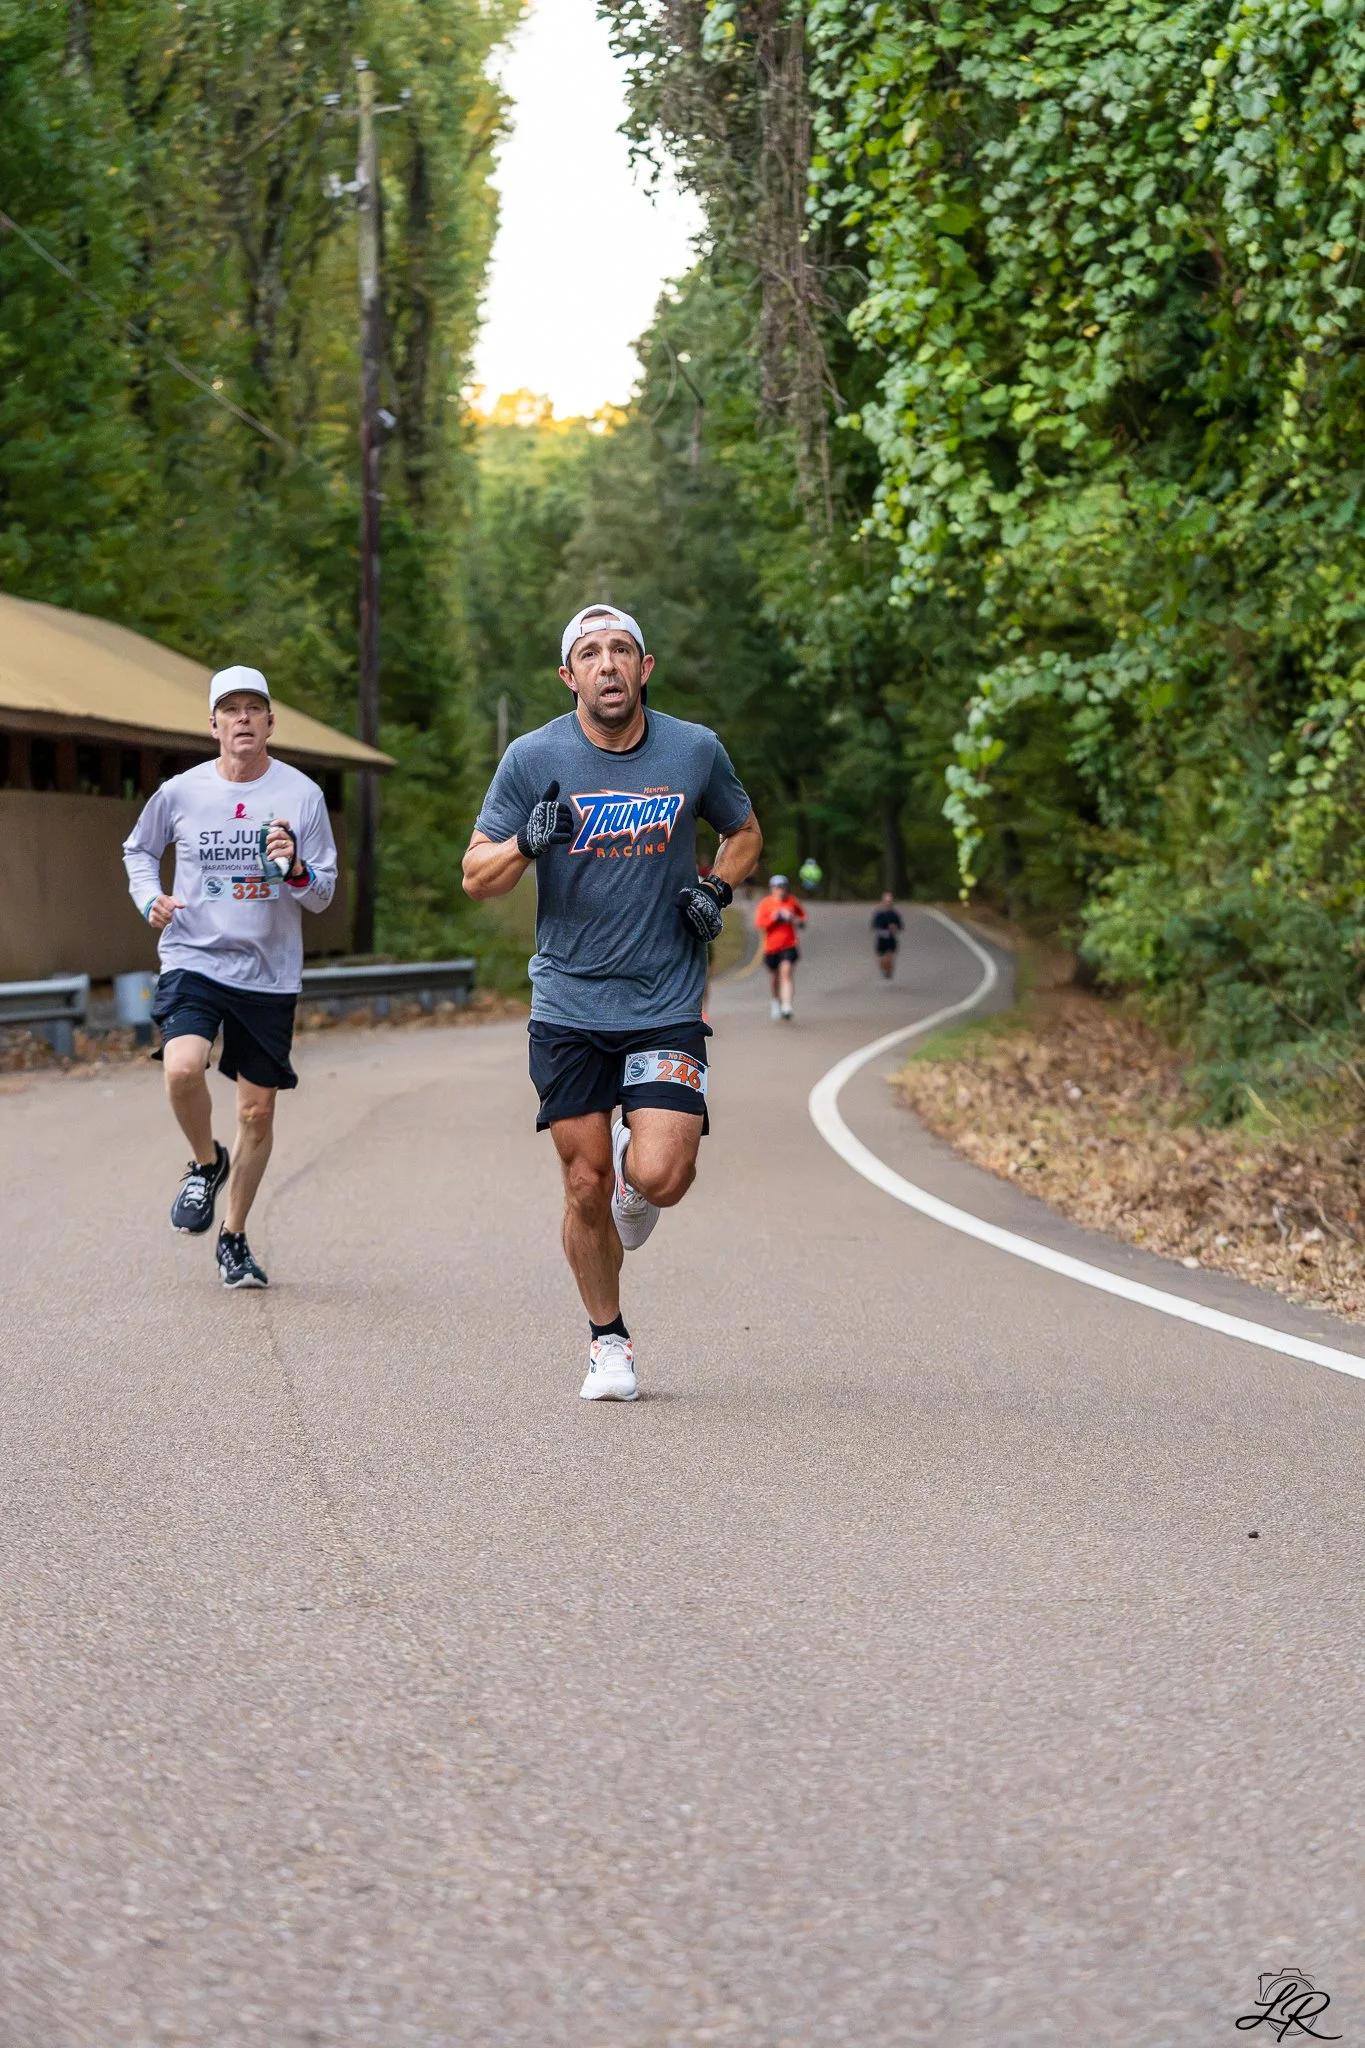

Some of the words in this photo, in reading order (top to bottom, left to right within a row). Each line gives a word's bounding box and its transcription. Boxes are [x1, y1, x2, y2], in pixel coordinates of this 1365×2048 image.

[568, 788, 685, 854] THUNDER
[199, 830, 224, 845] ST.
[596, 841, 666, 858] RACING
[232, 882, 272, 900] 325
[655, 1060, 702, 1090] 246
